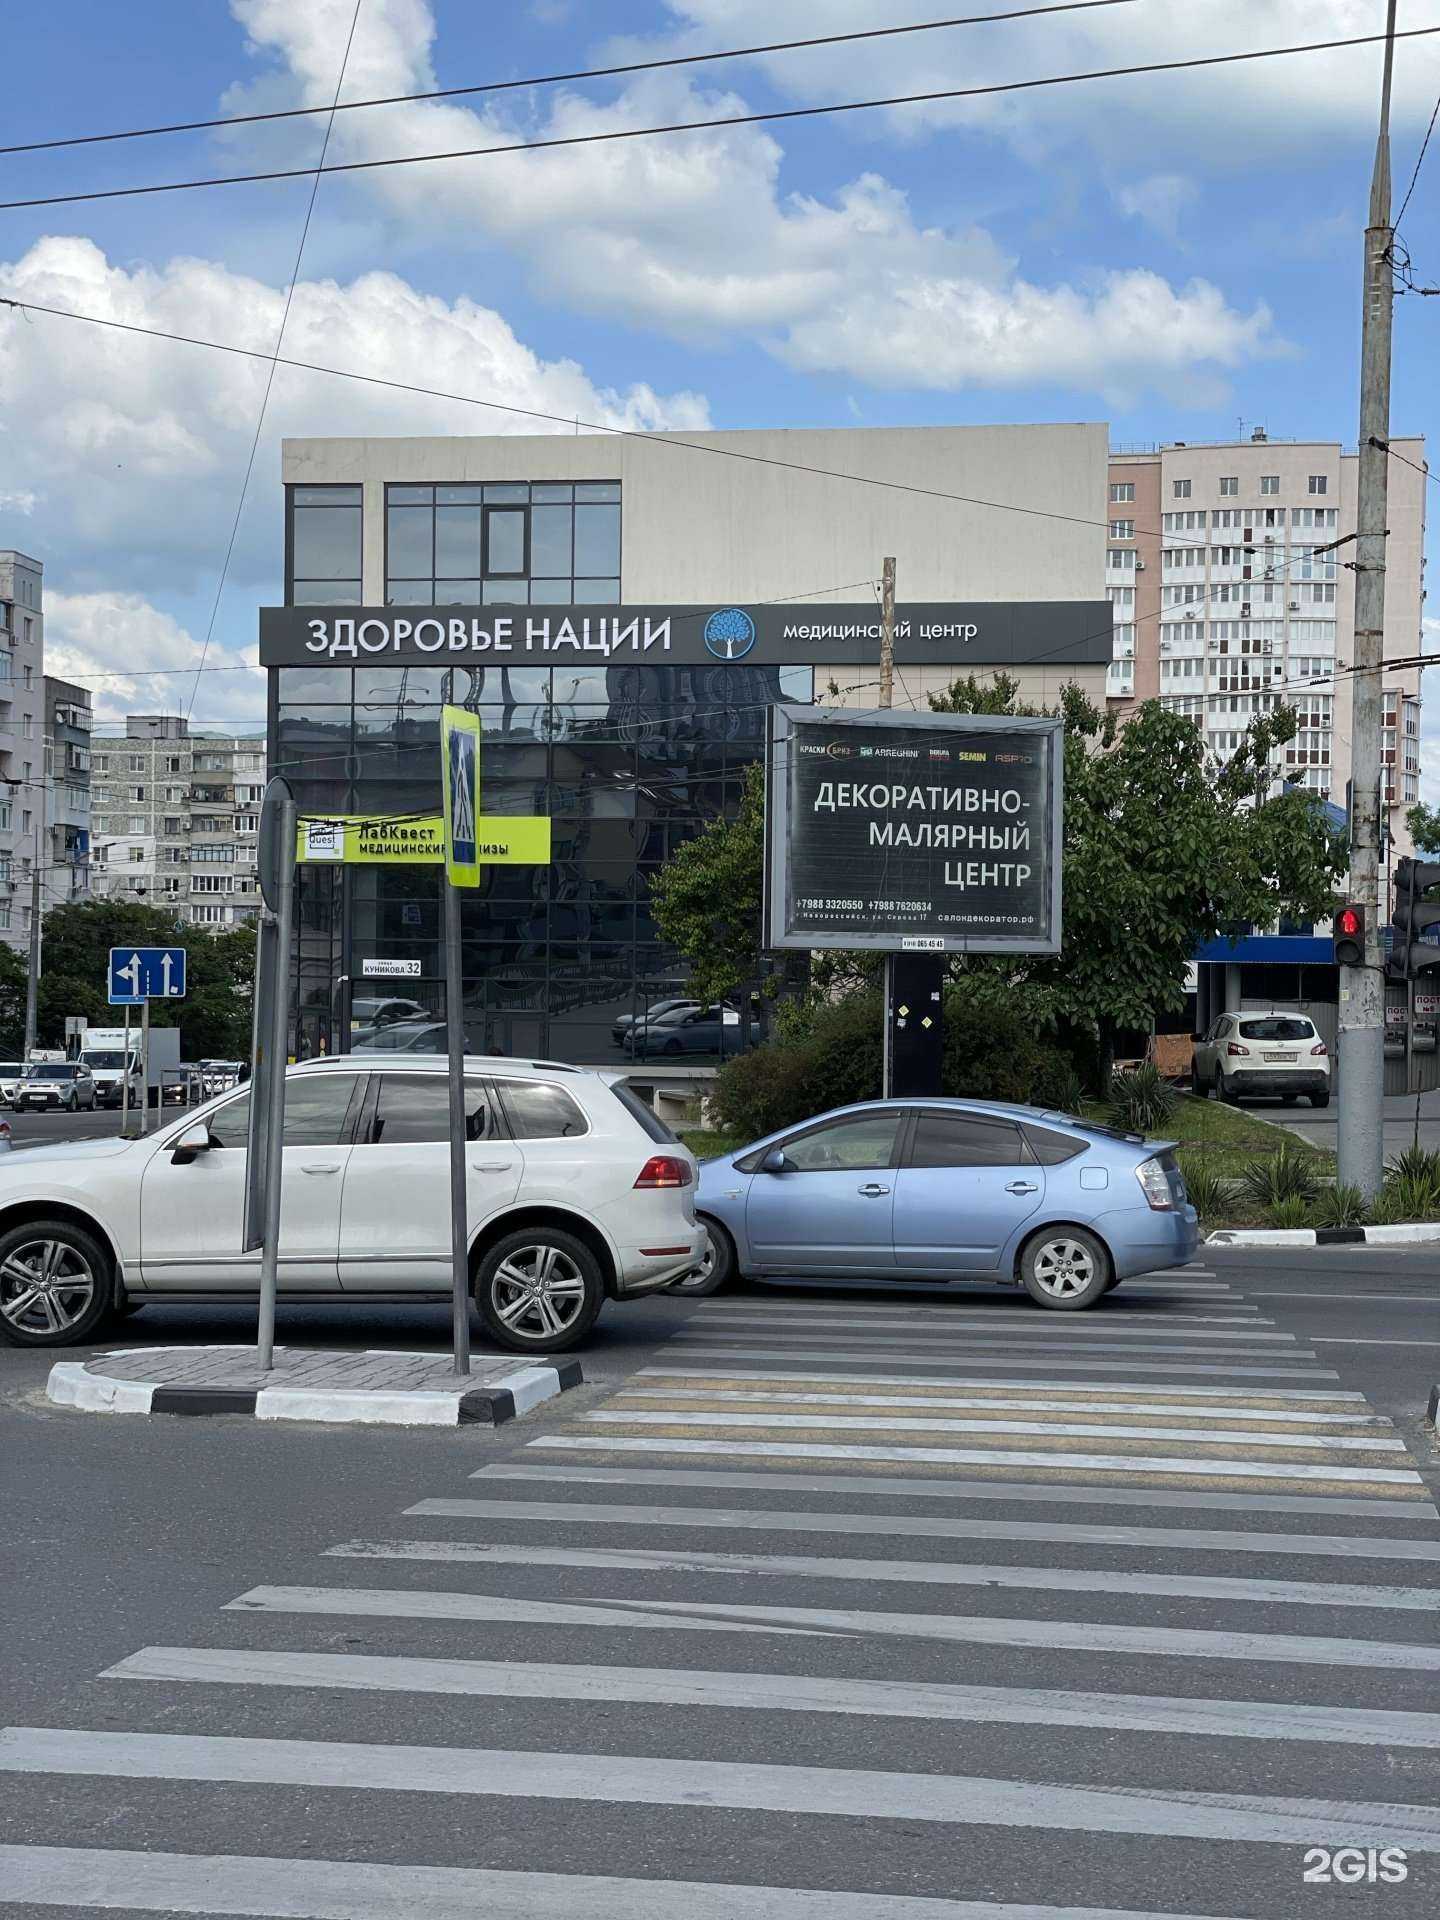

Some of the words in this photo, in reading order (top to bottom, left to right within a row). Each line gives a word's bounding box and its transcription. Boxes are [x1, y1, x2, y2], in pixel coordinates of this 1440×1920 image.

[305, 618, 513, 658] ЗДОРОВЬЕ
[526, 616, 671, 657] НАЦИИ
[783, 620, 911, 641] медицинсий
[919, 623, 978, 643] центр
[800, 745, 826, 754] КРАСКИ
[874, 748, 919, 758] ARREGHINI
[959, 751, 987, 762] SEMIN
[814, 782, 1030, 814] ДЕКОРАТИВНО-
[869, 820, 1030, 851] МАЛЯРНЫЙ
[944, 861, 1031, 891] ЦЕНТР
[364, 966, 405, 974] КУНИКОВА
[407, 962, 420, 974] 32
